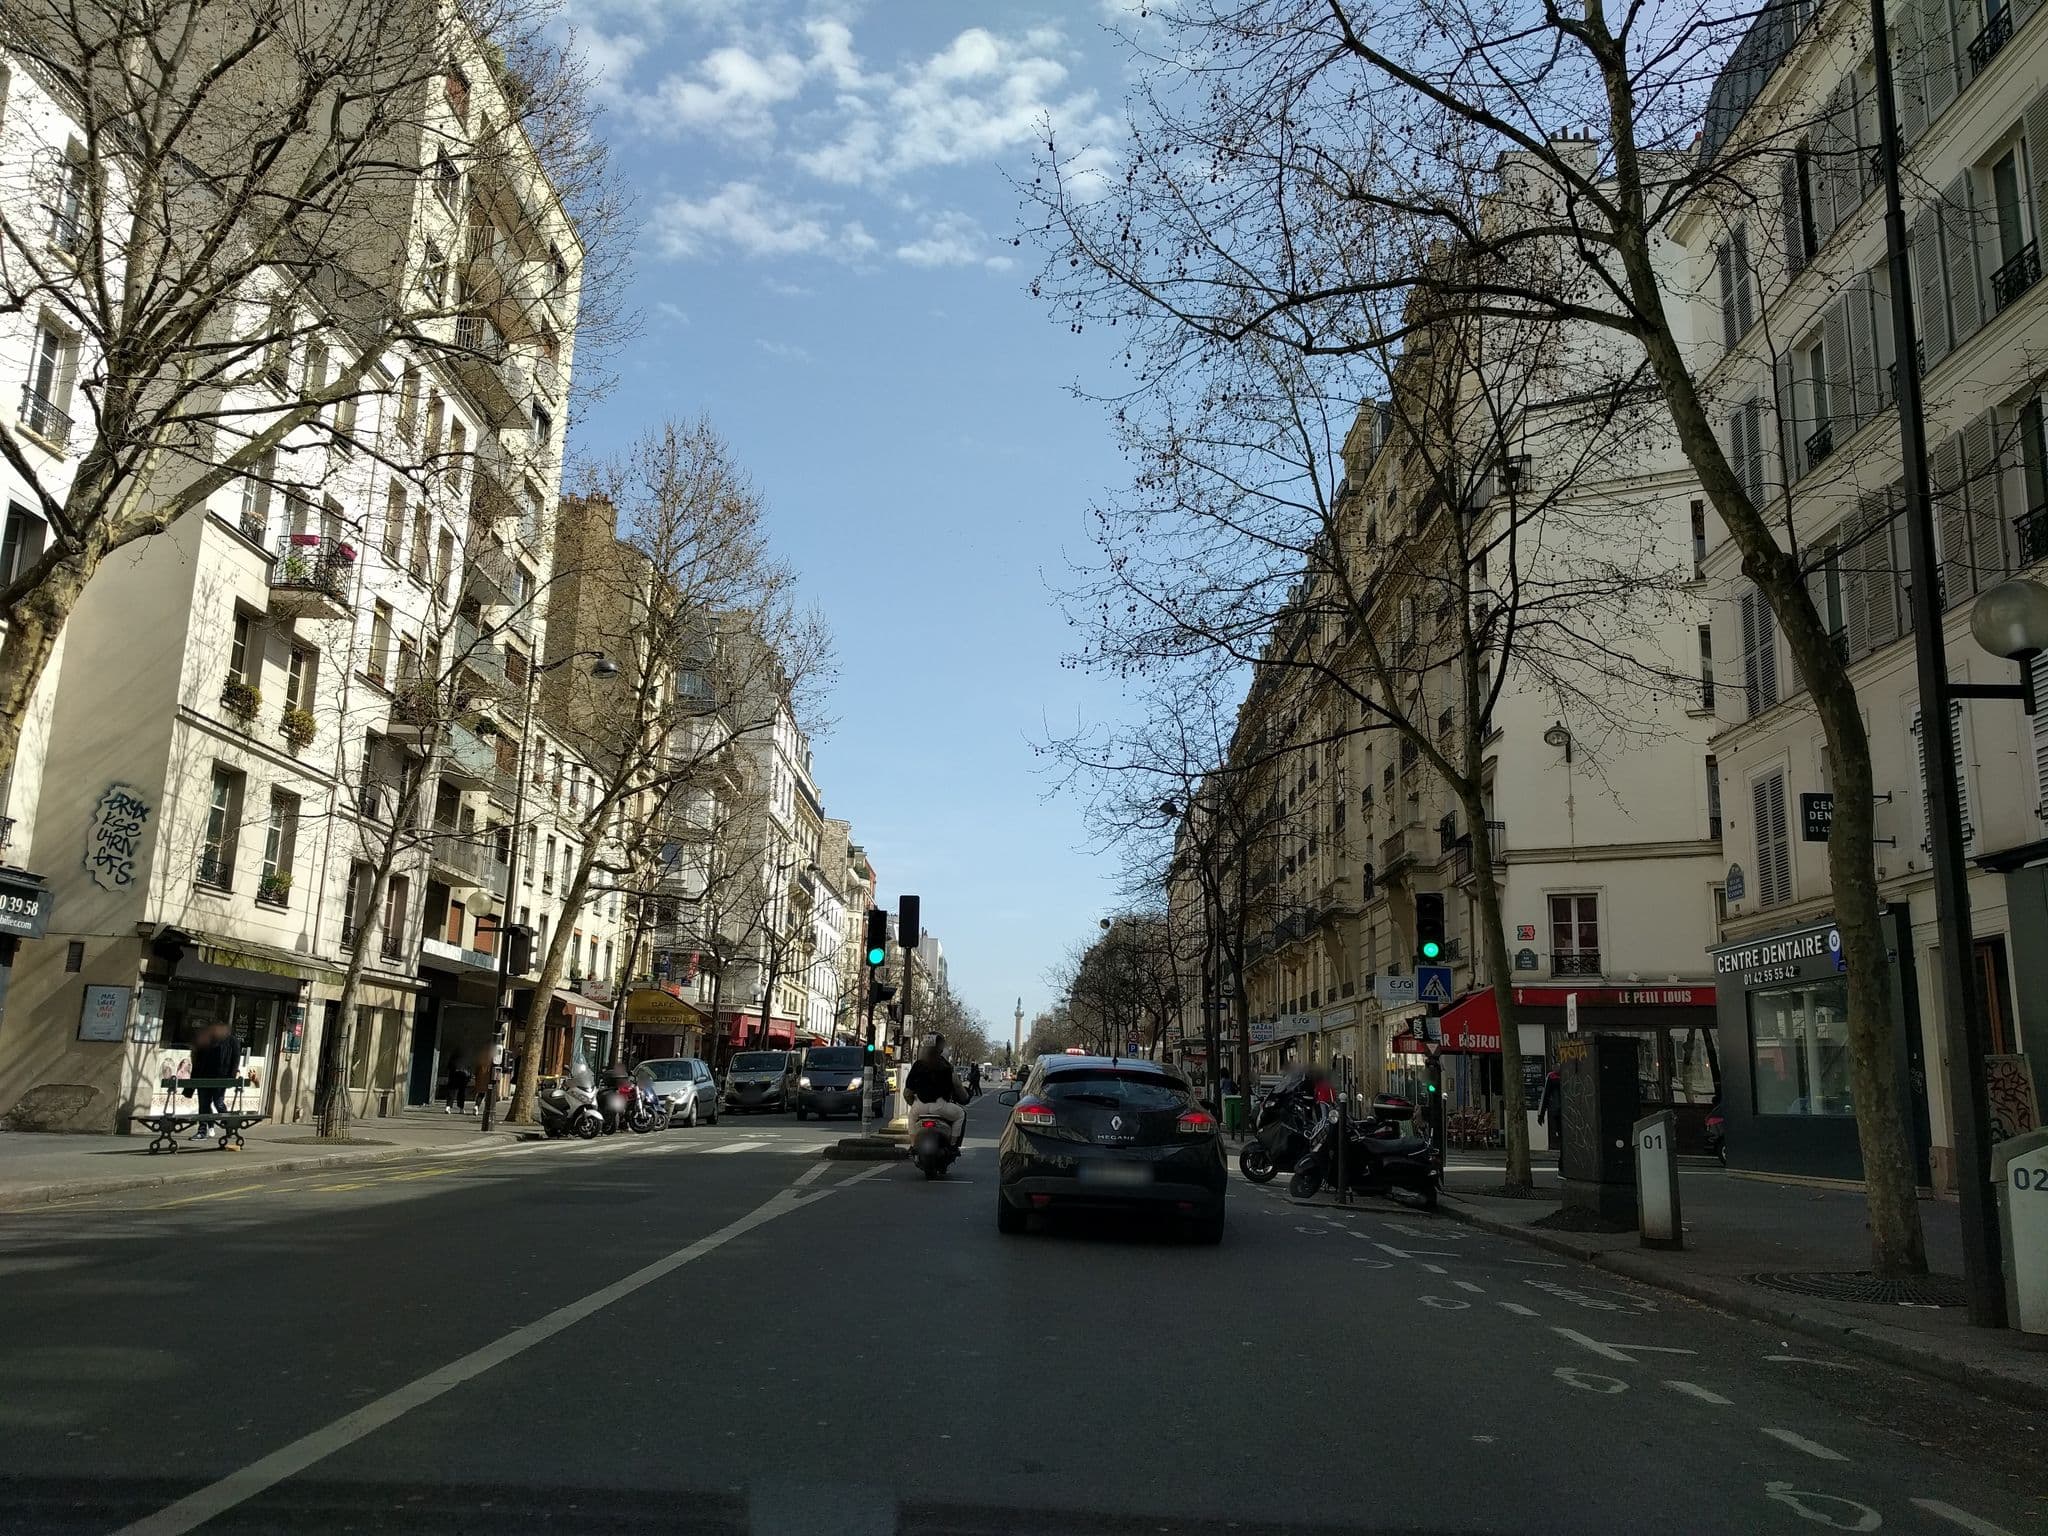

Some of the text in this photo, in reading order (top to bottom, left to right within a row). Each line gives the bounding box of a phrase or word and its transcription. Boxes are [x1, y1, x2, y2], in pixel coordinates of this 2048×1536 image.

[1813, 800, 1834, 810] CEN
[7, 896, 24, 913] 39
[23, 900, 39, 916] 58
[1717, 934, 1823, 974] CENTRE DENTAIRE
[1743, 965, 1795, 985] 01 42 55 55 42
[1619, 990, 1692, 1004] LE PETIT LOUIS
[1643, 1134, 1662, 1150] 01
[2013, 1167, 2048, 1192] 02
